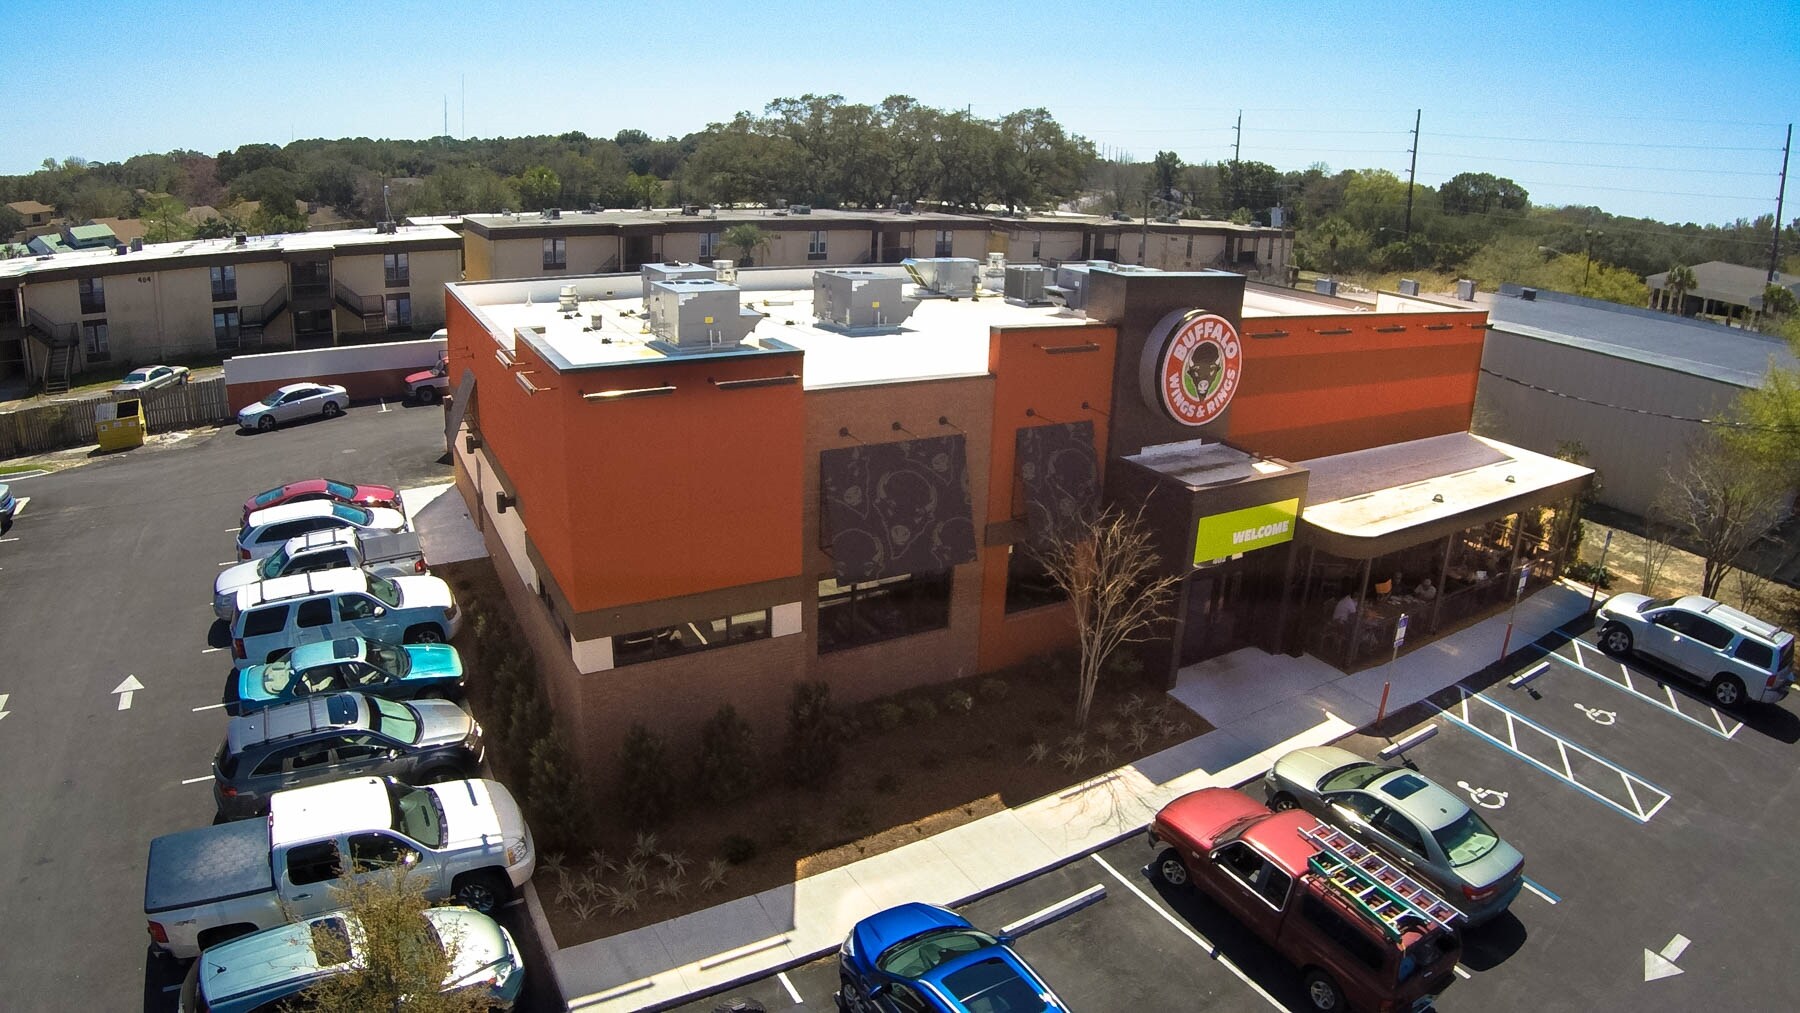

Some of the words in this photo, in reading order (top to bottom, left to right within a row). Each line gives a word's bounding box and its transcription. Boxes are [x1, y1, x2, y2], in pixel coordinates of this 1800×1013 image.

[1173, 321, 1238, 361] BUFFALO
[1169, 372, 1195, 417] WINGS
[1196, 406, 1206, 418] &
[1206, 369, 1236, 414] RINGS
[1233, 520, 1289, 544] WELCOME
